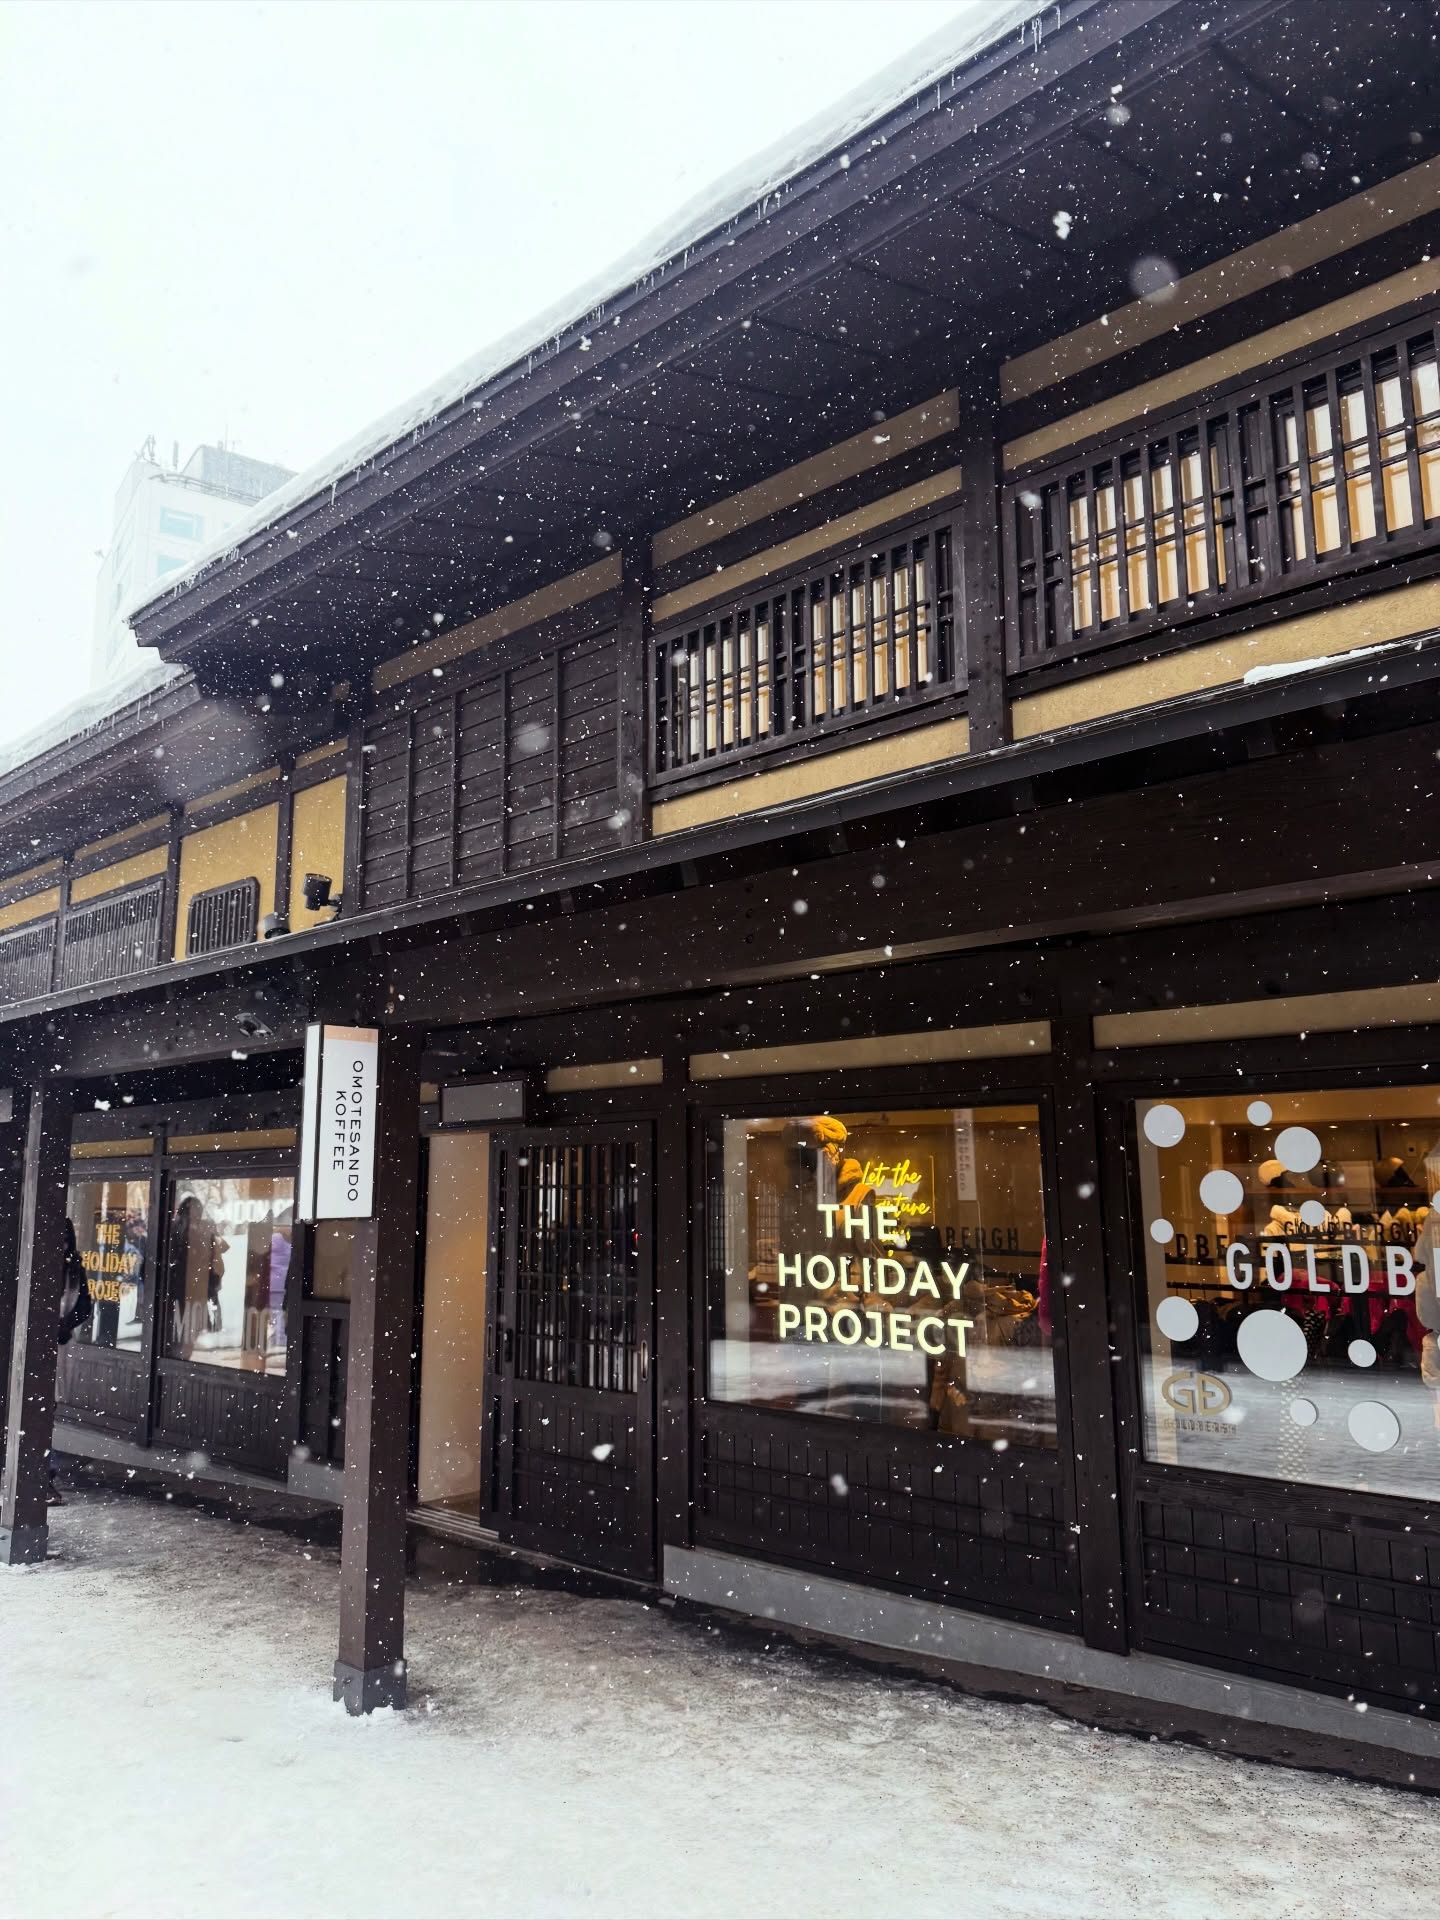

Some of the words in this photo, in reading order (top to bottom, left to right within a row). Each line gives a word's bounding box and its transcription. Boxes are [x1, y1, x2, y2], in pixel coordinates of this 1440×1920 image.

[333, 1090, 347, 1171] KOFFEE
[347, 1060, 364, 1201] OMOTESANDO
[861, 1161, 891, 1187] Let
[891, 1159, 922, 1188] the
[96, 1223, 120, 1245] THE
[817, 1203, 899, 1241] THE
[932, 1226, 1019, 1250] BERGH
[80, 1250, 138, 1275] HOLIDAY
[777, 1252, 970, 1300] HOLIDAY
[1225, 1242, 1440, 1298] GOLDB
[778, 1303, 975, 1358] PROJECT
